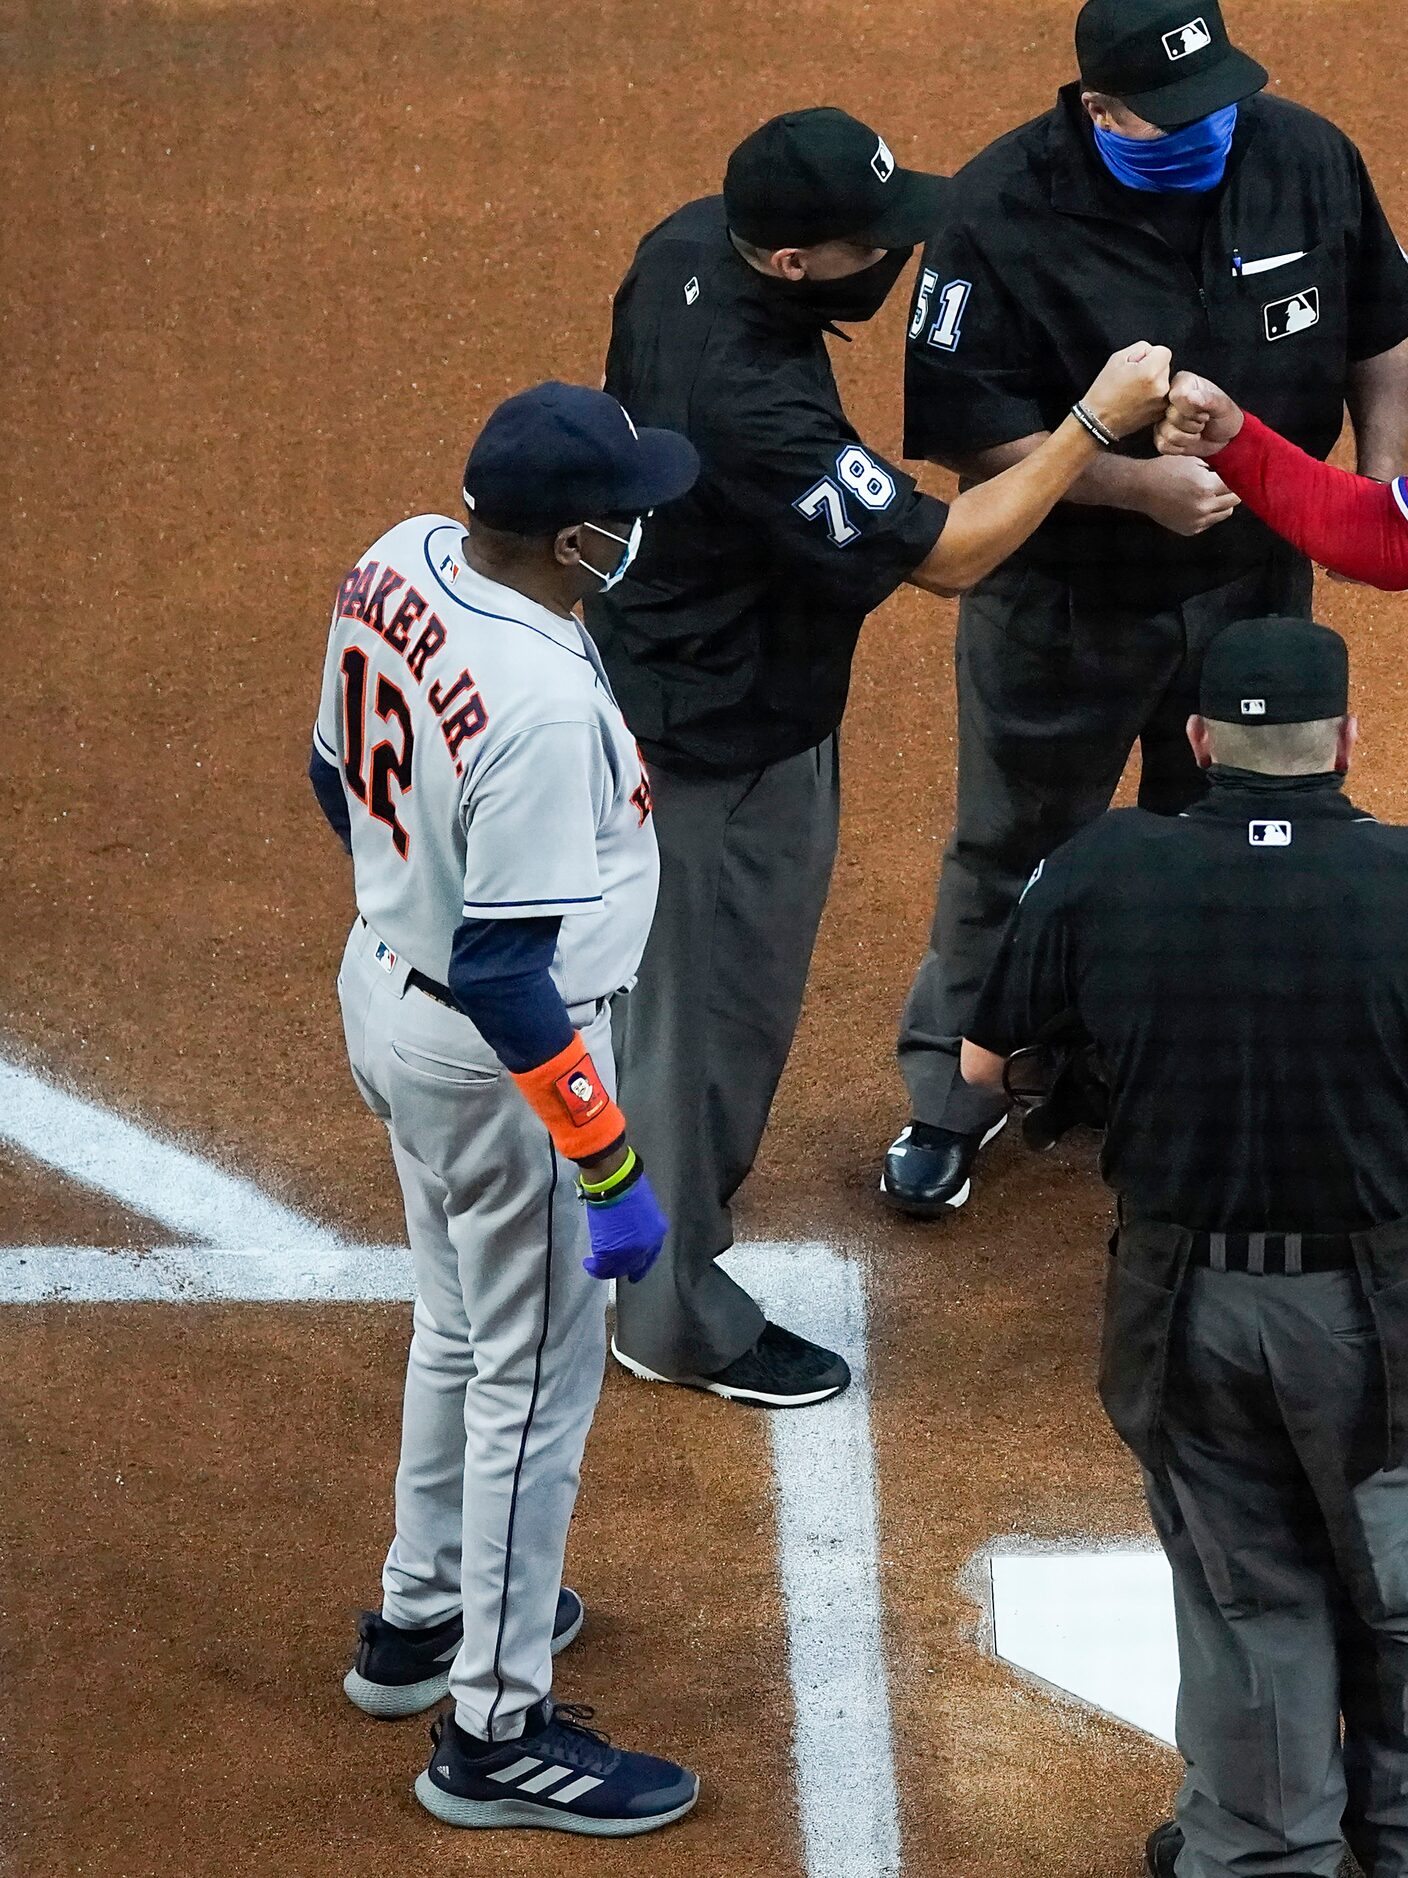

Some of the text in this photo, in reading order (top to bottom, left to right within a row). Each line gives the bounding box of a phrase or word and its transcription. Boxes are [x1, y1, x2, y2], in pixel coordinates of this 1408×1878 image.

[909, 268, 972, 352] 51
[791, 445, 896, 548] 78
[339, 645, 415, 862] 12
[427, 667, 490, 779] JR.
